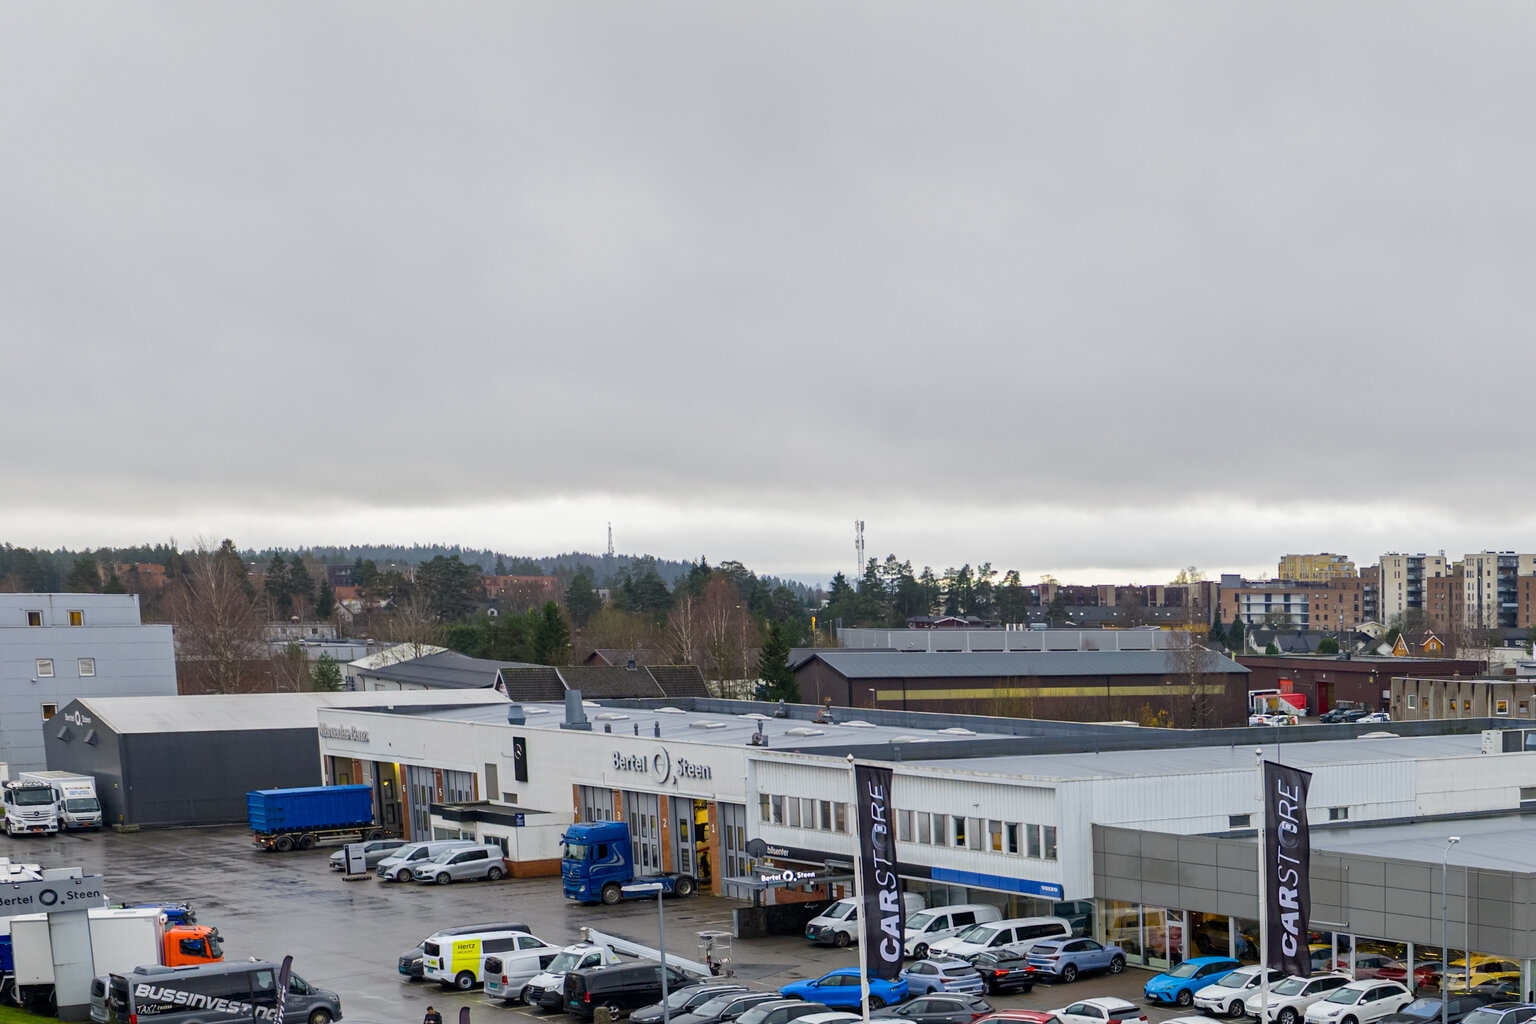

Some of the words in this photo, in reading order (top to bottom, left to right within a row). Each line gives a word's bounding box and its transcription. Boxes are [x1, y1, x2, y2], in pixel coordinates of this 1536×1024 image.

[613, 751, 648, 773] Bertel
[677, 757, 712, 780] Steen
[617, 811, 621, 821] 3
[662, 818, 667, 828] 2
[711, 823, 716, 833] 1
[868, 780, 900, 963] CARSTORE
[1278, 779, 1300, 957] CARSTORE
[761, 873, 782, 882] Bertel
[796, 871, 816, 879] Steen
[1041, 885, 1059, 893] VOLVO
[66, 890, 100, 900] Steen
